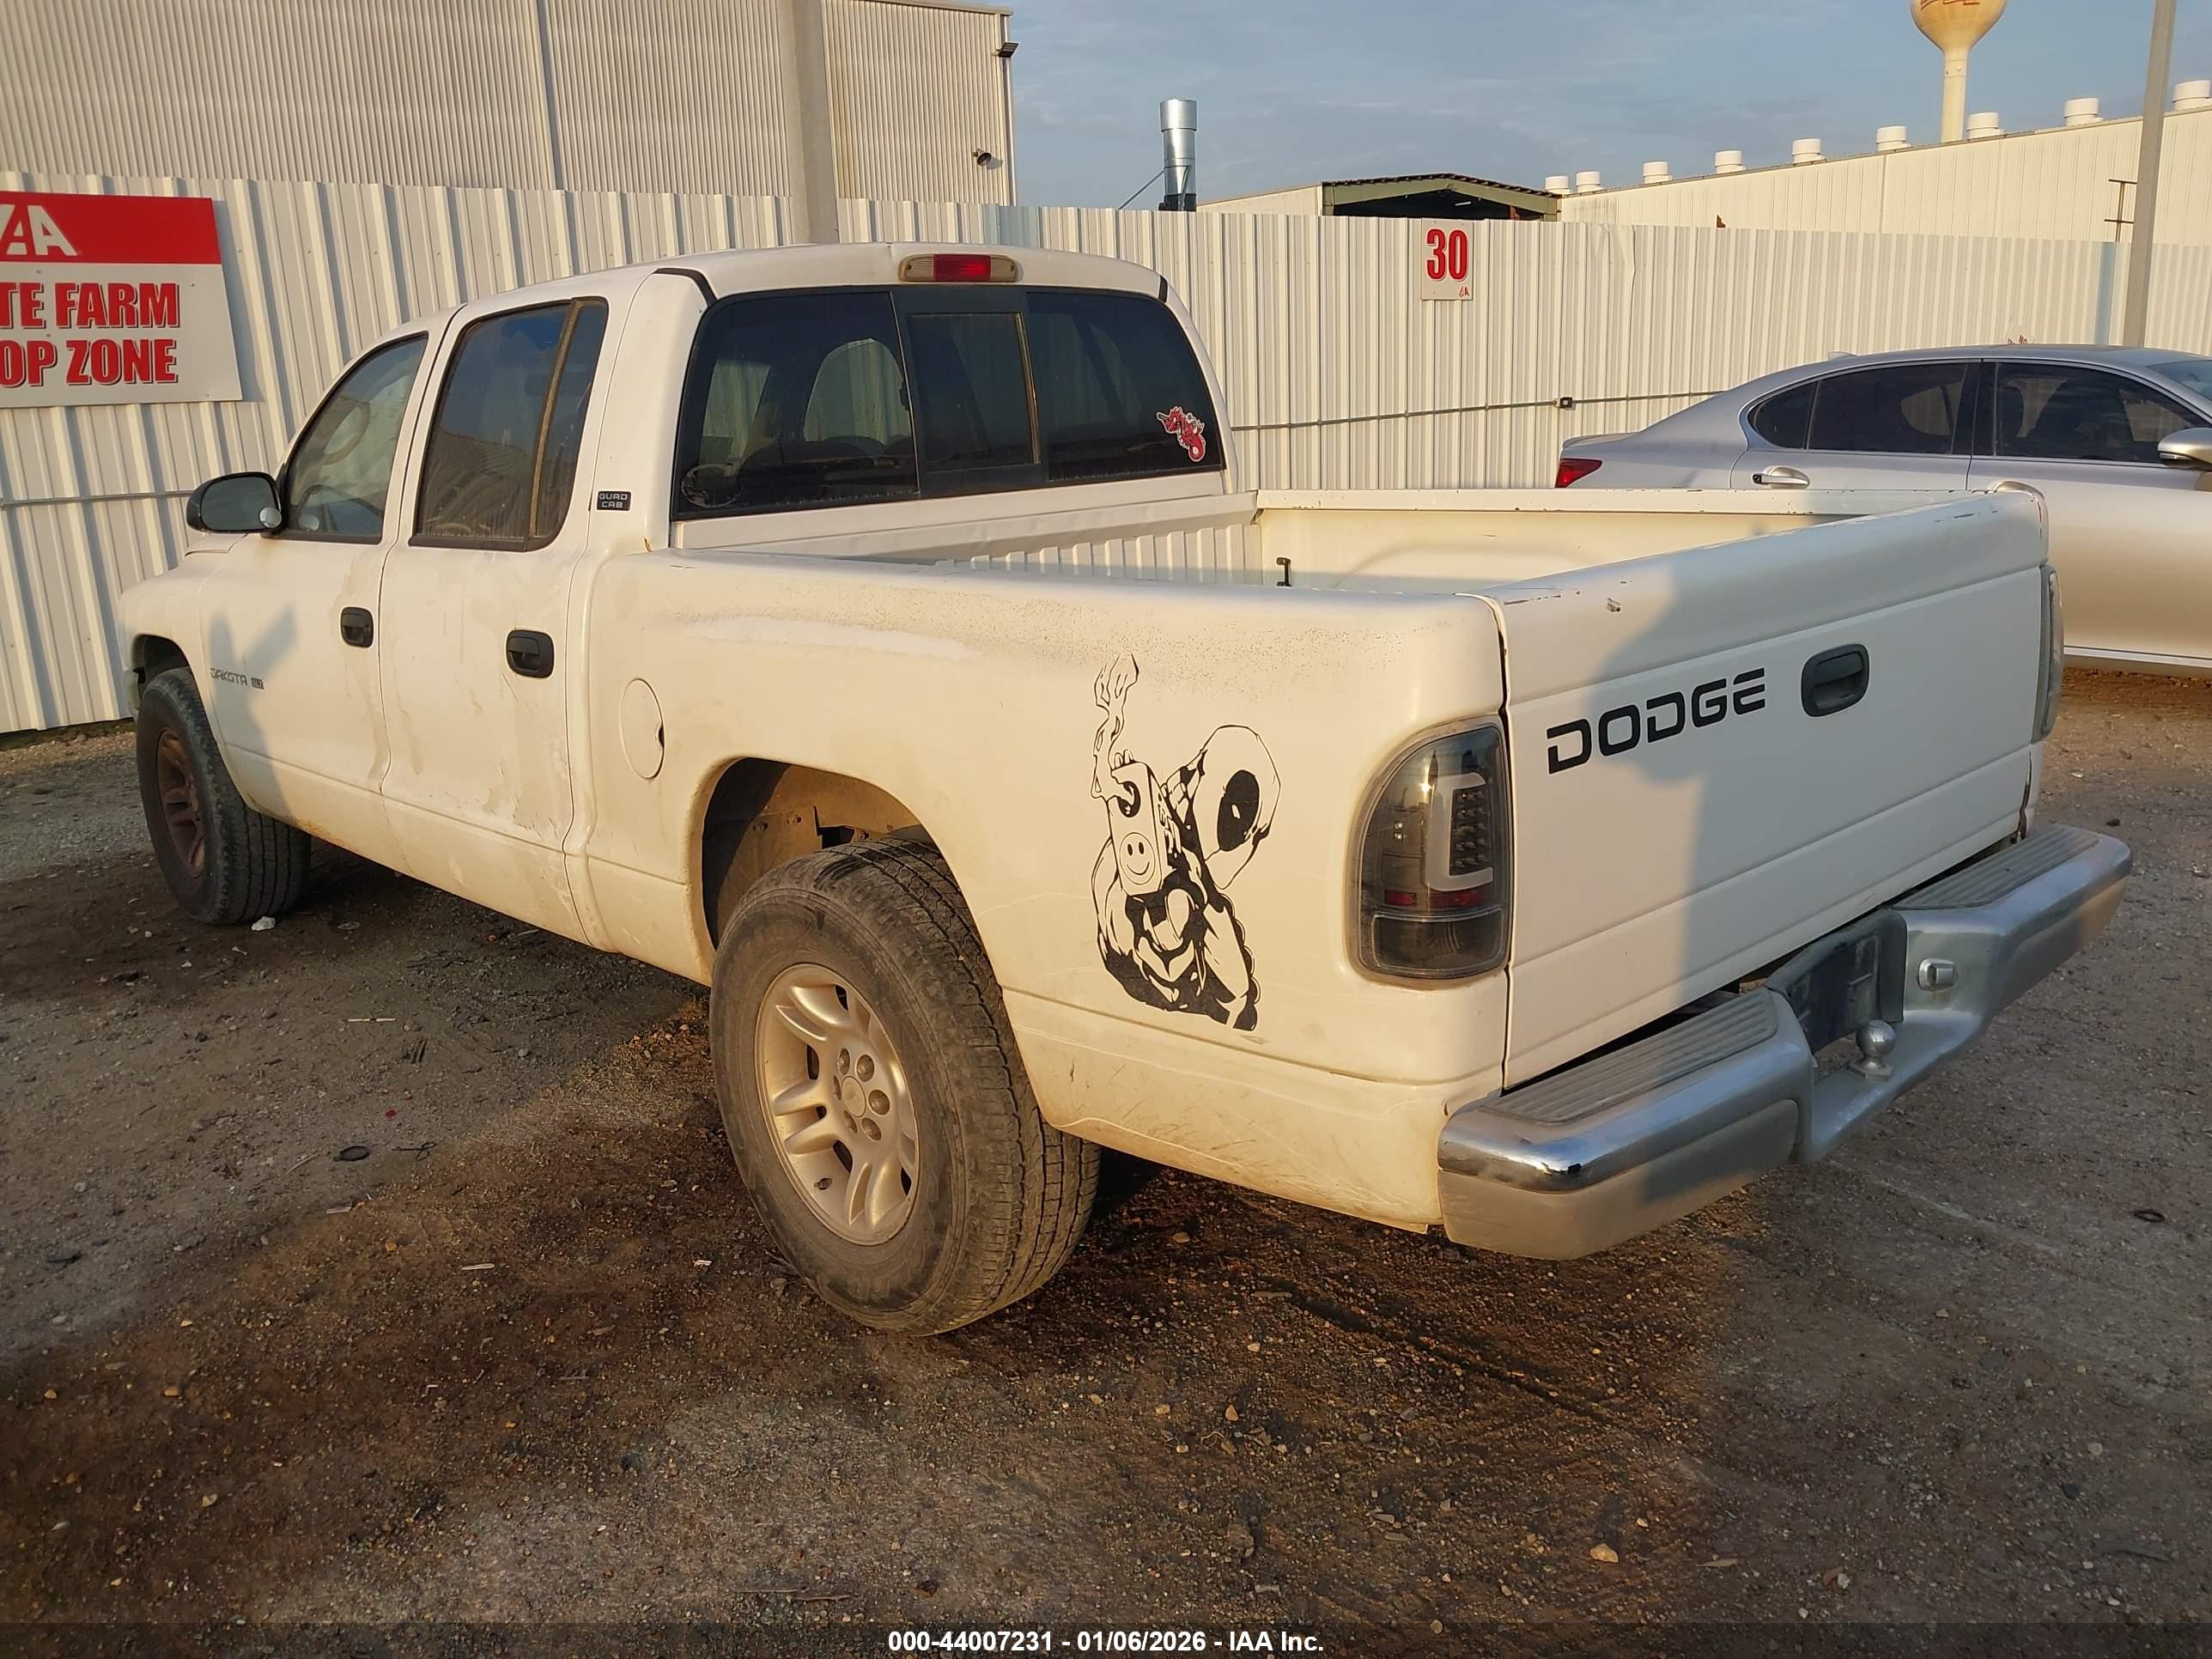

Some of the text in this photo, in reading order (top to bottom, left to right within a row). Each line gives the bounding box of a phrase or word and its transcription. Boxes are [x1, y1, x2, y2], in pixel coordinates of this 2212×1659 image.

[1426, 228, 1468, 281] 30
[0, 283, 179, 328] TE FARM
[0, 339, 178, 387] OP ZONE
[210, 667, 248, 687] DAKOTA
[1546, 667, 1765, 775] DODGE
